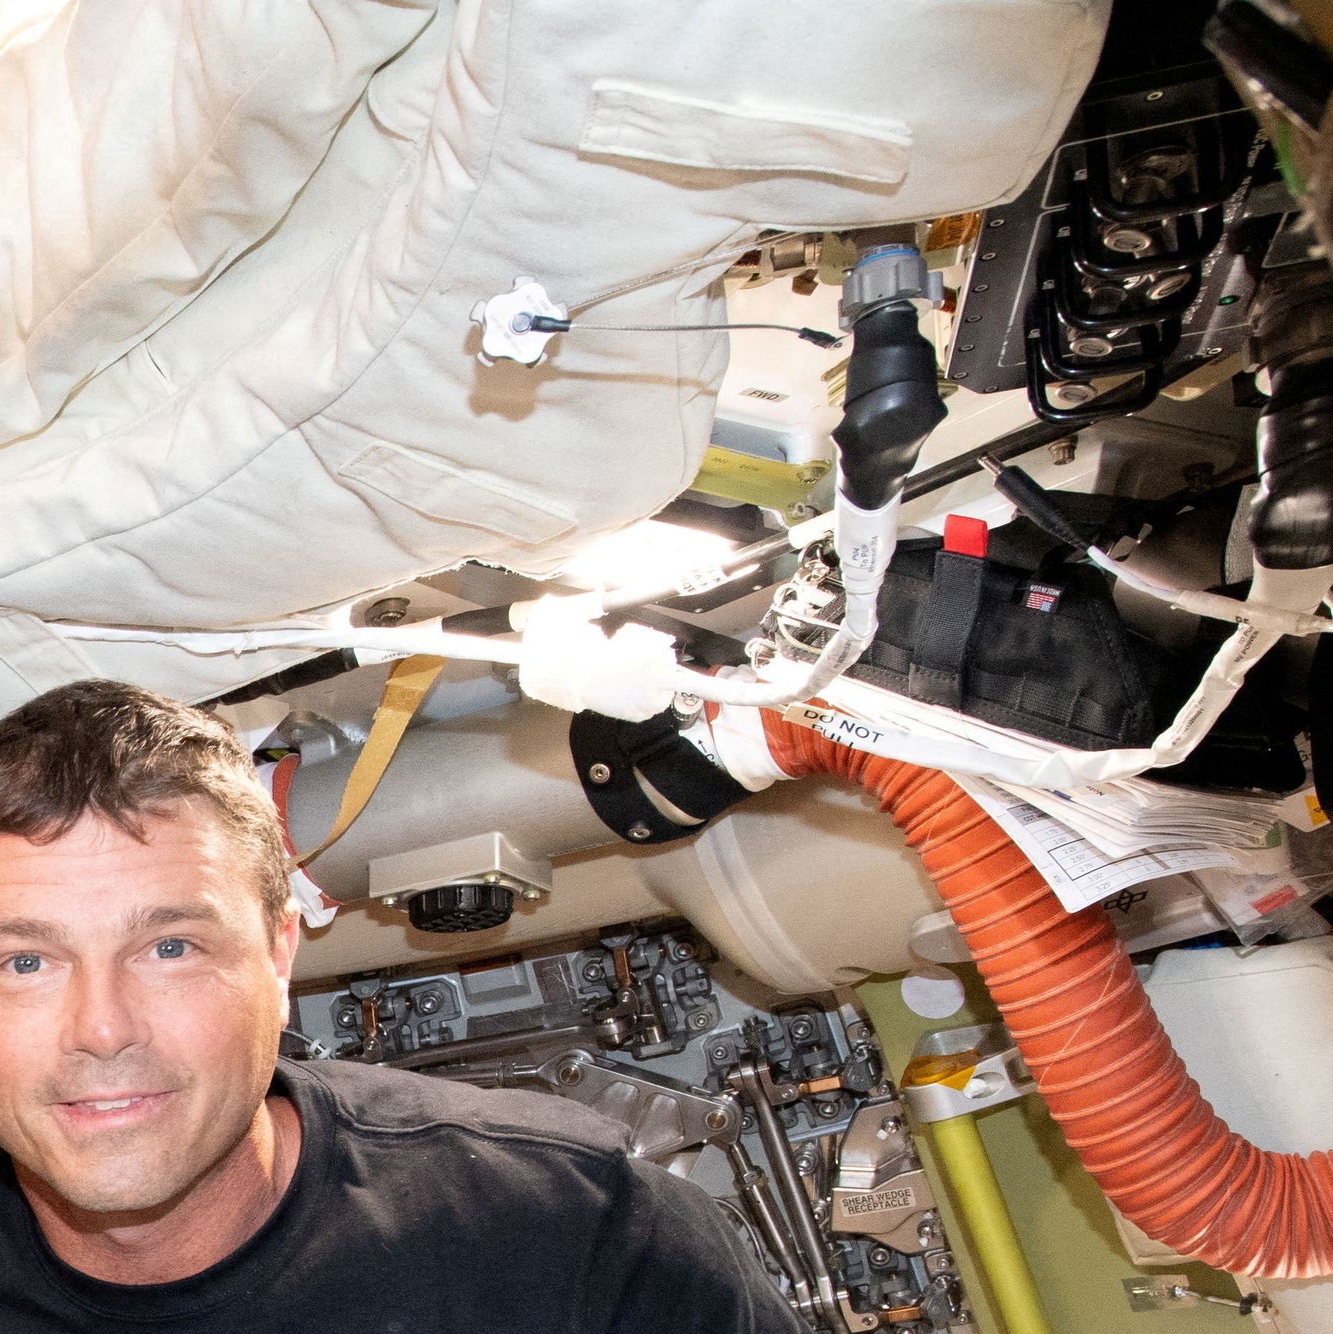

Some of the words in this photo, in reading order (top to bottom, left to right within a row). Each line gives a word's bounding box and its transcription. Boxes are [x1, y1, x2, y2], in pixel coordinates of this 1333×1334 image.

[749, 390, 780, 401] FWD
[804, 709, 834, 724] DO
[839, 720, 884, 744] NOT
[842, 1195, 873, 1207] SHEAR
[876, 1188, 911, 1200] WEDGE
[848, 1198, 910, 1215] RECEPTACLE
